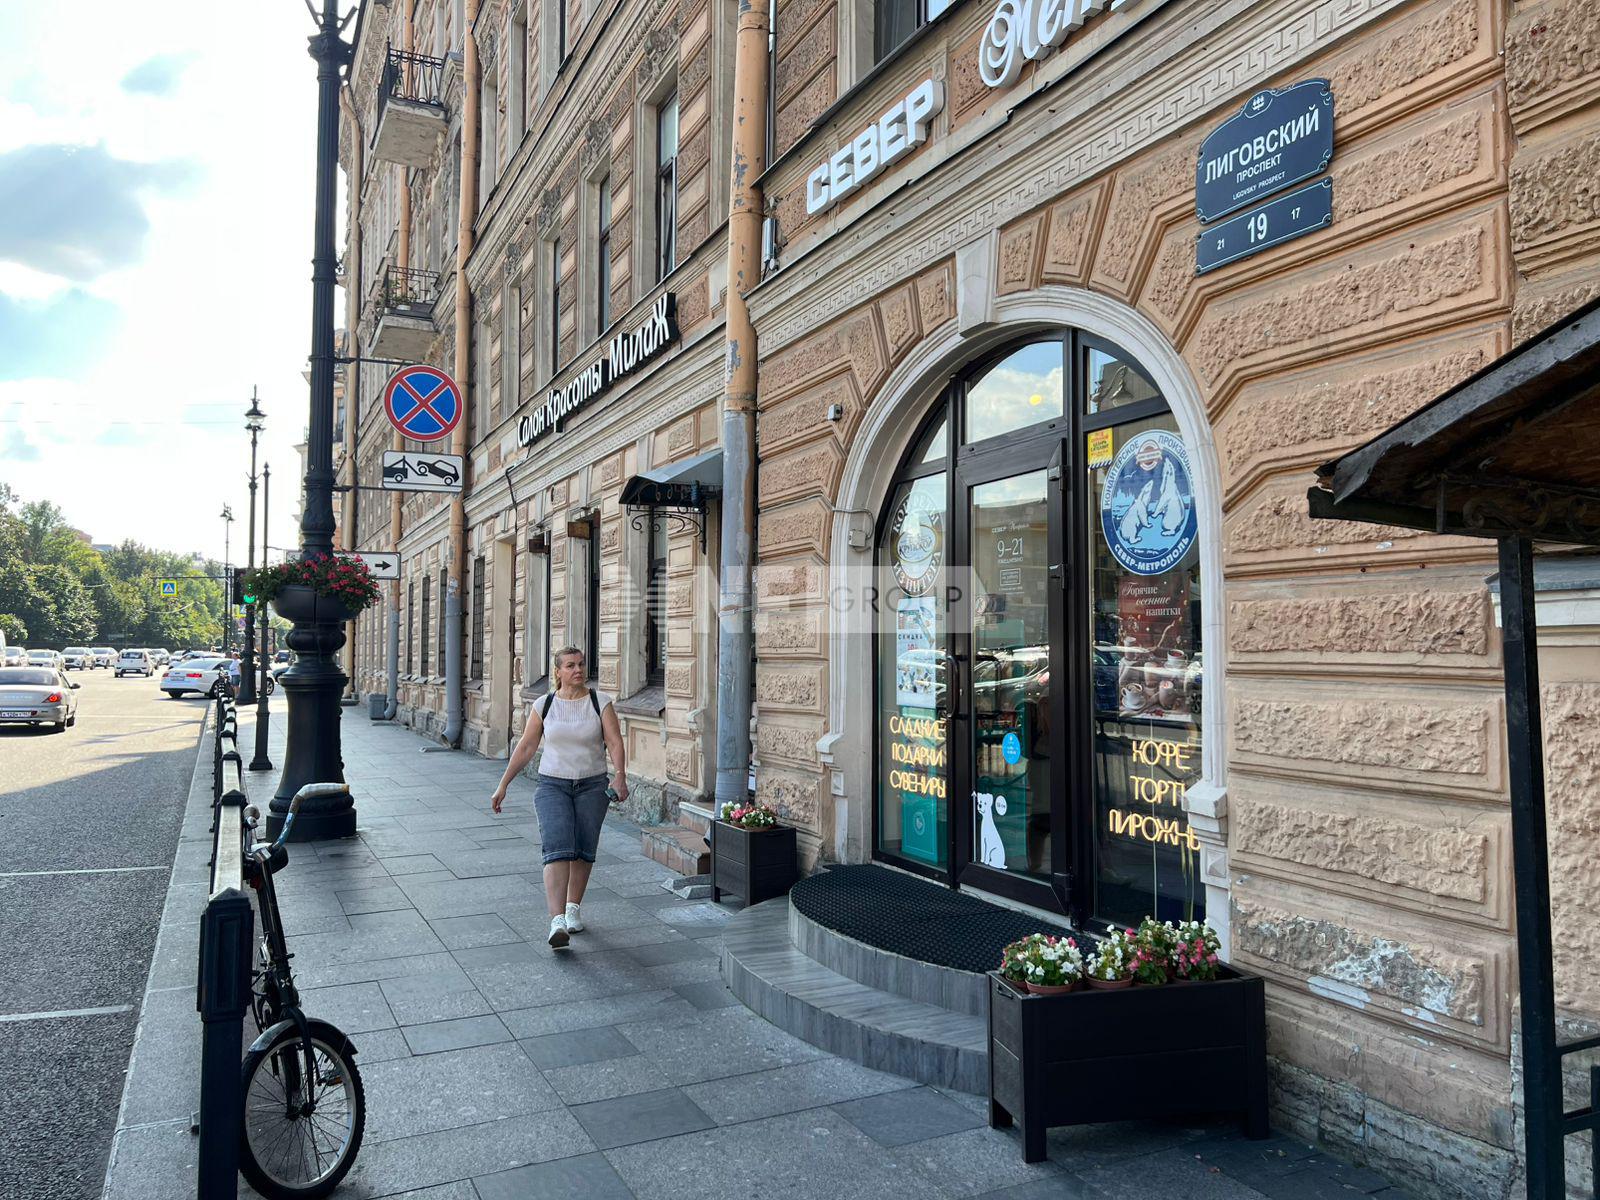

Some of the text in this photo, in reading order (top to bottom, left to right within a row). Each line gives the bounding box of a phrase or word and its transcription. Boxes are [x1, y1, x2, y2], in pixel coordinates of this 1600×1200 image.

[806, 79, 940, 215] СЕВЕР
[1204, 104, 1319, 184] ЛИГОВСКИЙ
[1236, 153, 1282, 183] ПРОСПЕКТ
[1232, 171, 1286, 200] LIGOVSKY PROSPECT
[1216, 207, 1301, 250] 21 19 17
[517, 405, 545, 447] Салон
[547, 359, 604, 432] Красоты
[1104, 439, 1139, 507] КОНДИТЕРСКОЕ
[1114, 536, 1190, 571] СЕВЕР-МЕТРОПОЛЬ
[1145, 607, 1181, 617] напитки
[889, 715, 946, 740] СЛАДКИЕ
[891, 742, 943, 767] ПОДАРКИ
[1132, 740, 1192, 770] КОФЕ
[889, 770, 946, 798] СУВЕНИРЫ
[1129, 775, 1186, 806] ТОРТ
